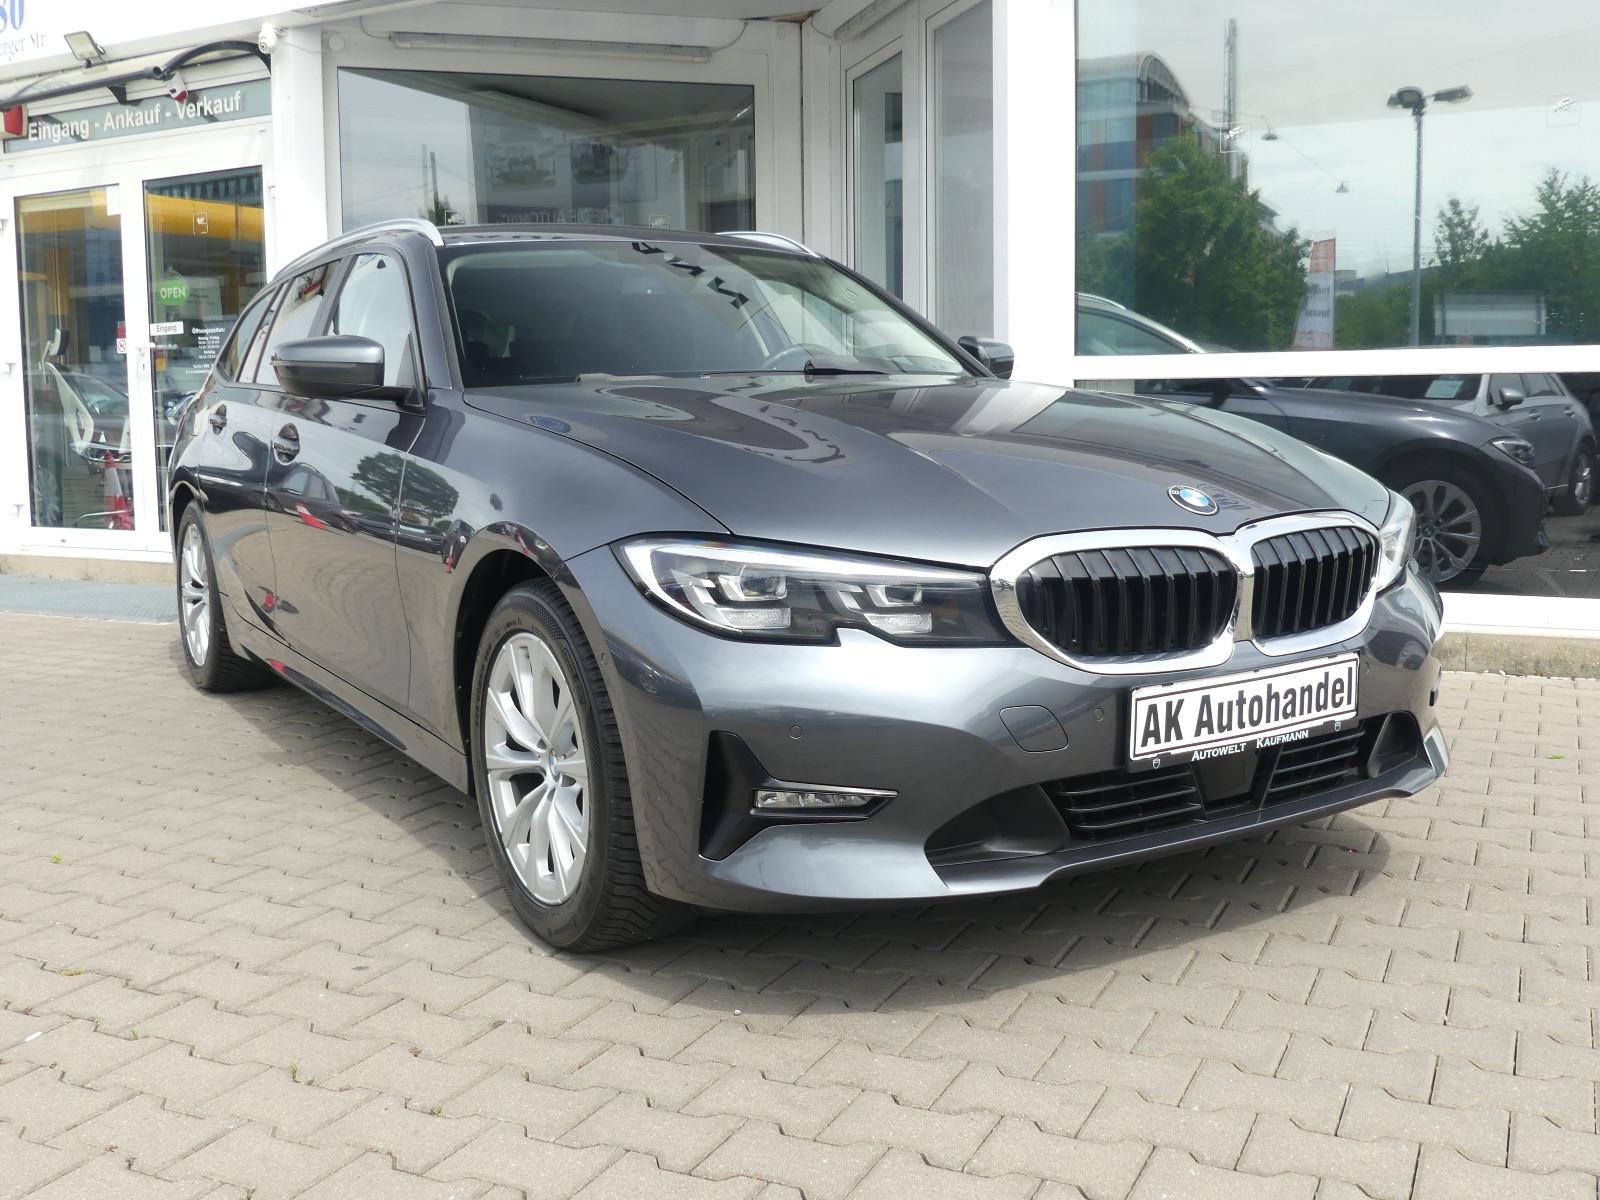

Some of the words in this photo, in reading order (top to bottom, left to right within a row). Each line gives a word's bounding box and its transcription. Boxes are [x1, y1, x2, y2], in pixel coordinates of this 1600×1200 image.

[28, 118, 90, 142] Eingang
[103, 103, 161, 131] Ankauf
[176, 90, 241, 119] Verkauf
[160, 287, 186, 299] OPEN
[156, 324, 178, 334] Eingang
[1140, 698, 1186, 748] AK
[1194, 666, 1354, 738] Autohandel
[1191, 742, 1247, 762] AUTOWELT
[1256, 729, 1310, 749] KAUFMANN
